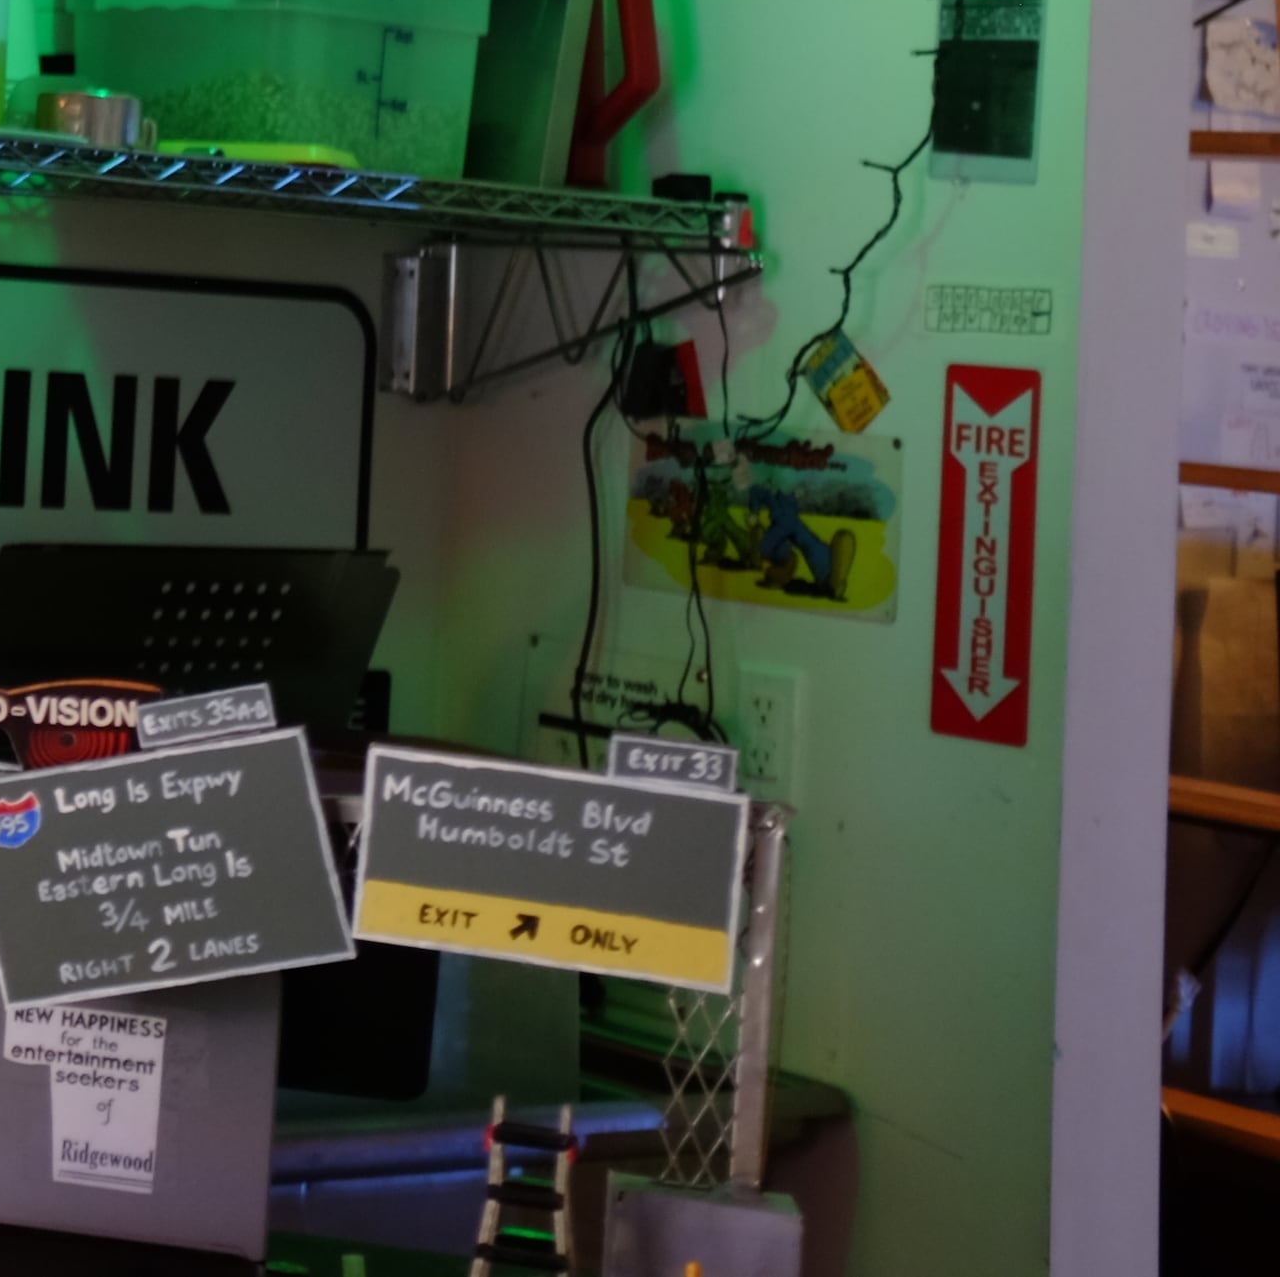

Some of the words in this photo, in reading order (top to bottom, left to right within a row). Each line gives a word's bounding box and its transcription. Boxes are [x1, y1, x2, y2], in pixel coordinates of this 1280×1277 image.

[955, 423, 1027, 459] FIRE
[966, 461, 1000, 698] EXTINGUISHER
[143, 710, 201, 735] EXITS
[627, 747, 687, 773] EXIT
[687, 750, 726, 782] 33
[54, 785, 116, 814] Long
[127, 779, 151, 804] Is
[161, 770, 242, 805] Expwy
[383, 773, 555, 823] McGuinness
[582, 799, 654, 838] Blvd
[57, 838, 164, 874] Midtown
[166, 828, 222, 855] Tun
[417, 813, 575, 860] Humboldt
[588, 838, 631, 869] St
[38, 868, 144, 904] Eastern
[153, 859, 219, 889] Long
[225, 850, 254, 879] Is
[98, 897, 150, 934] 3/4
[163, 897, 219, 926] MILE
[418, 902, 479, 930] EXIT
[569, 923, 640, 956] ONLY
[58, 953, 135, 985] RIGHT
[146, 937, 178, 973] 2
[188, 932, 261, 962] LANES
[14, 1007, 54, 1024] NEW
[61, 1011, 165, 1040] HAPPINESS
[60, 1030, 82, 1045] for
[92, 1036, 119, 1053] the
[11, 1045, 157, 1076] entertainment
[55, 1069, 140, 1092] seekers
[96, 1097, 115, 1126] of
[60, 1137, 155, 1174] Ridgewood
